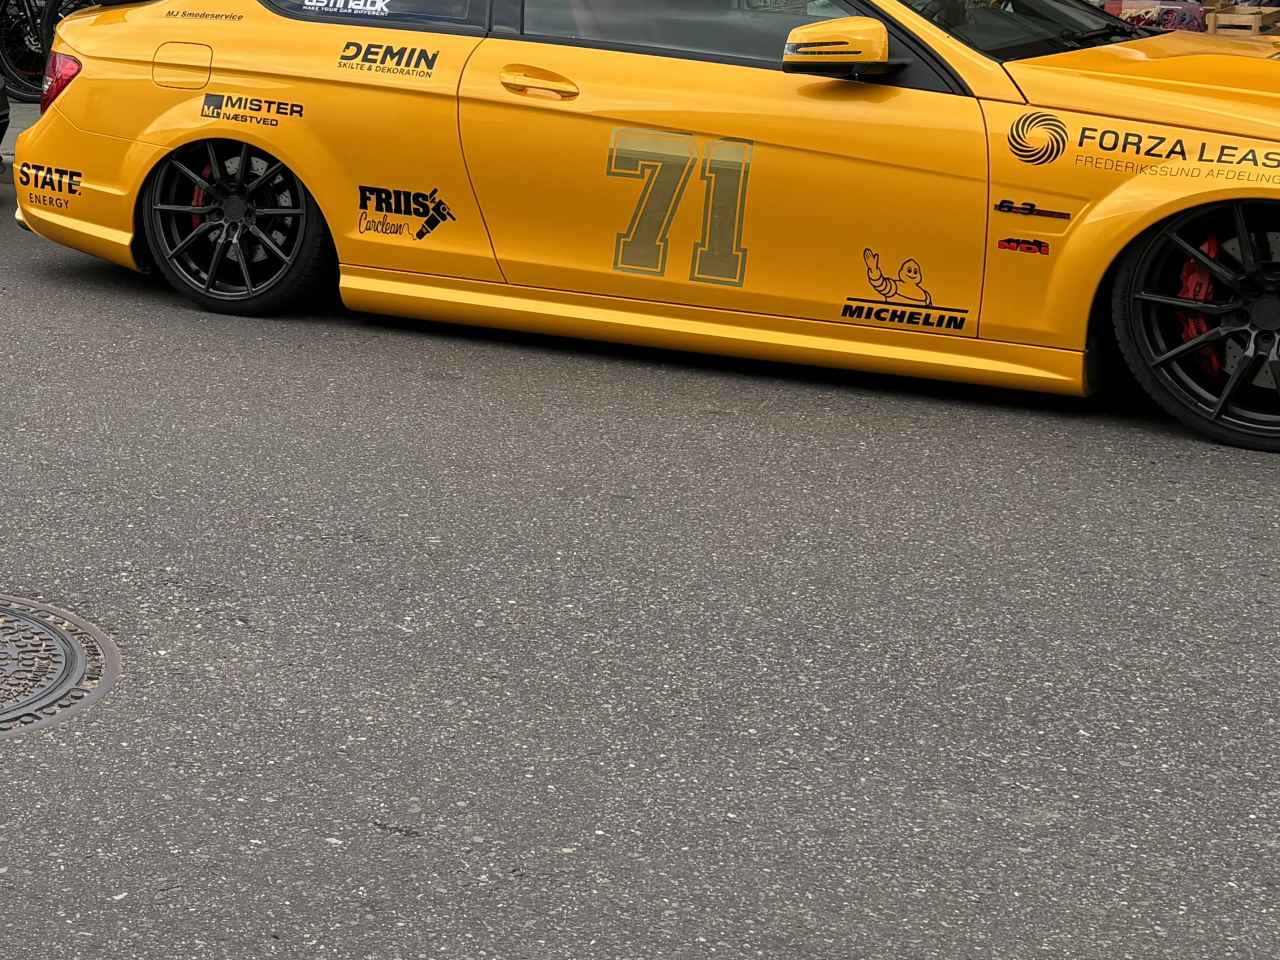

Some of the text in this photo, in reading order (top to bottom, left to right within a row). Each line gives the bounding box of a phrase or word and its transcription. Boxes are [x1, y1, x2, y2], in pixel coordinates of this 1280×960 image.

[339, 41, 440, 70] DEMIN
[337, 61, 365, 72] SKILTE
[375, 65, 433, 79] DEKORATION
[224, 95, 304, 118] MISTER
[222, 112, 279, 127] NÆSTVED
[1078, 127, 1188, 161] FORZA
[1075, 154, 1202, 179] FREDERIKSSUND
[28, 192, 69, 209] ENERGY
[358, 185, 431, 218] FRIIS
[606, 127, 754, 288] 71
[358, 211, 405, 236] Carclean
[840, 303, 967, 331] MICHELIN
